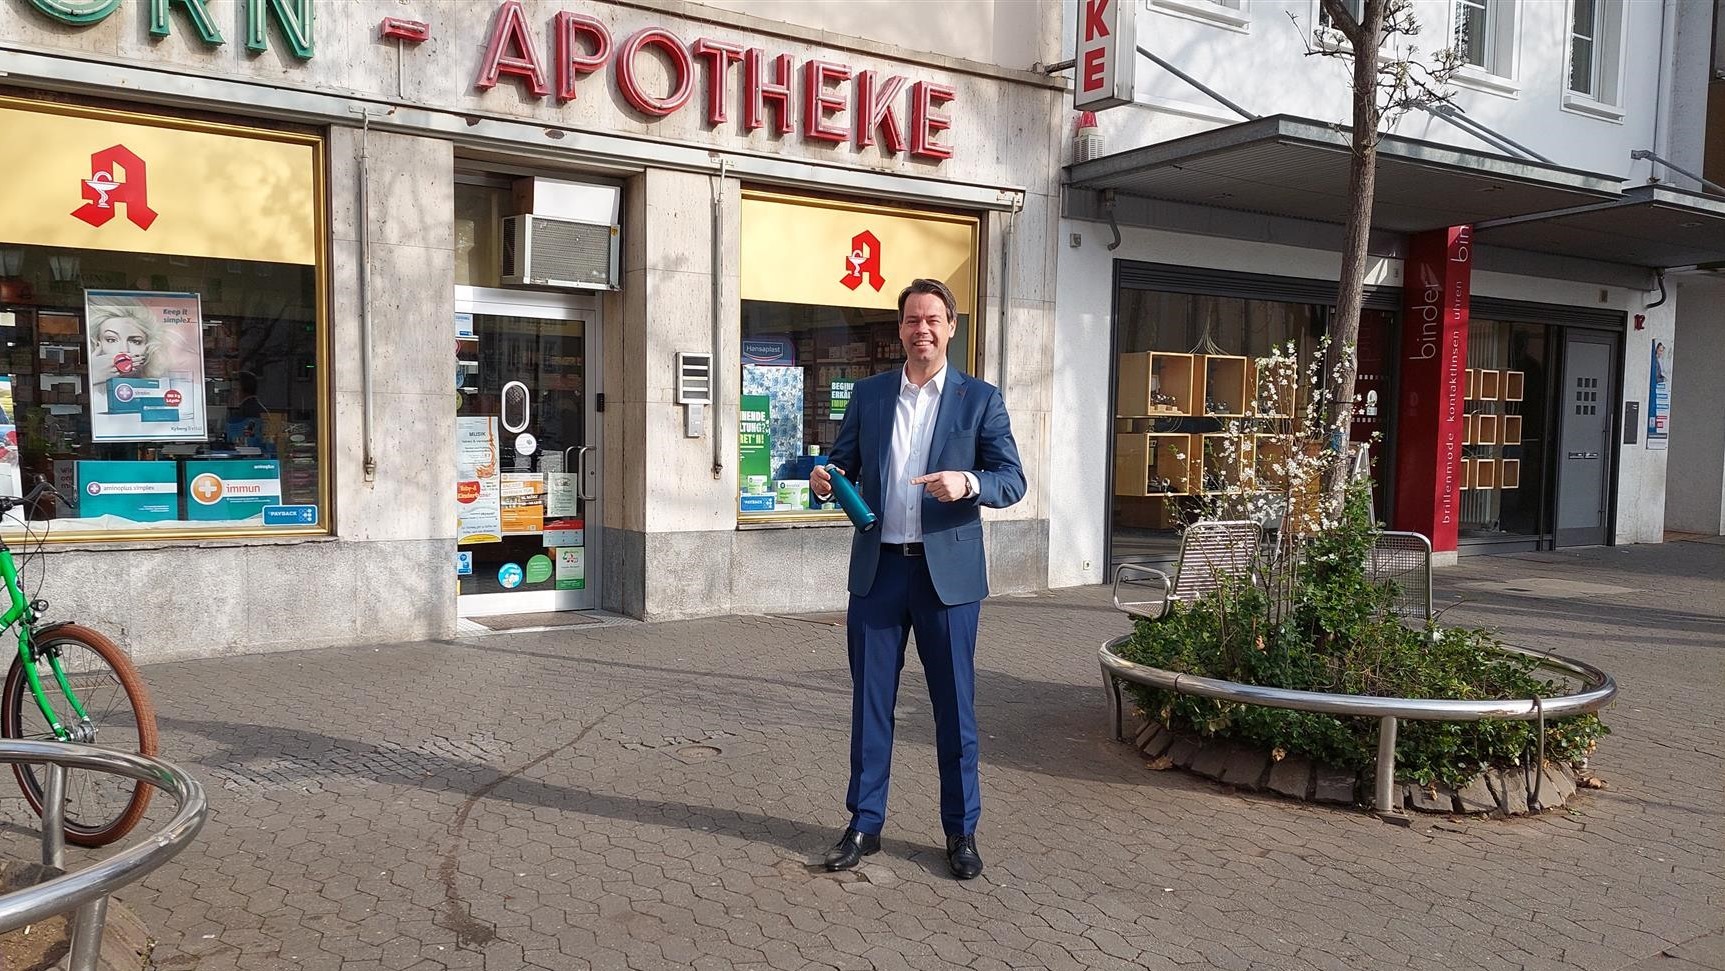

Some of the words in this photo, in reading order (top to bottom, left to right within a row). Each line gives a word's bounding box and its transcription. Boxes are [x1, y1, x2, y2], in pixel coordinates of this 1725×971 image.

[474, 0, 956, 160] APOTHEKE
[163, 308, 181, 317] Keep
[1409, 279, 1439, 359] binder
[1453, 281, 1462, 320] uhren
[746, 344, 781, 354] Hansaplast
[1447, 331, 1460, 422] kontaktlinsen
[103, 484, 132, 492] aminoplus
[133, 484, 155, 492] simplex
[226, 483, 261, 493] immun
[1442, 433, 1453, 524] brillenmode
